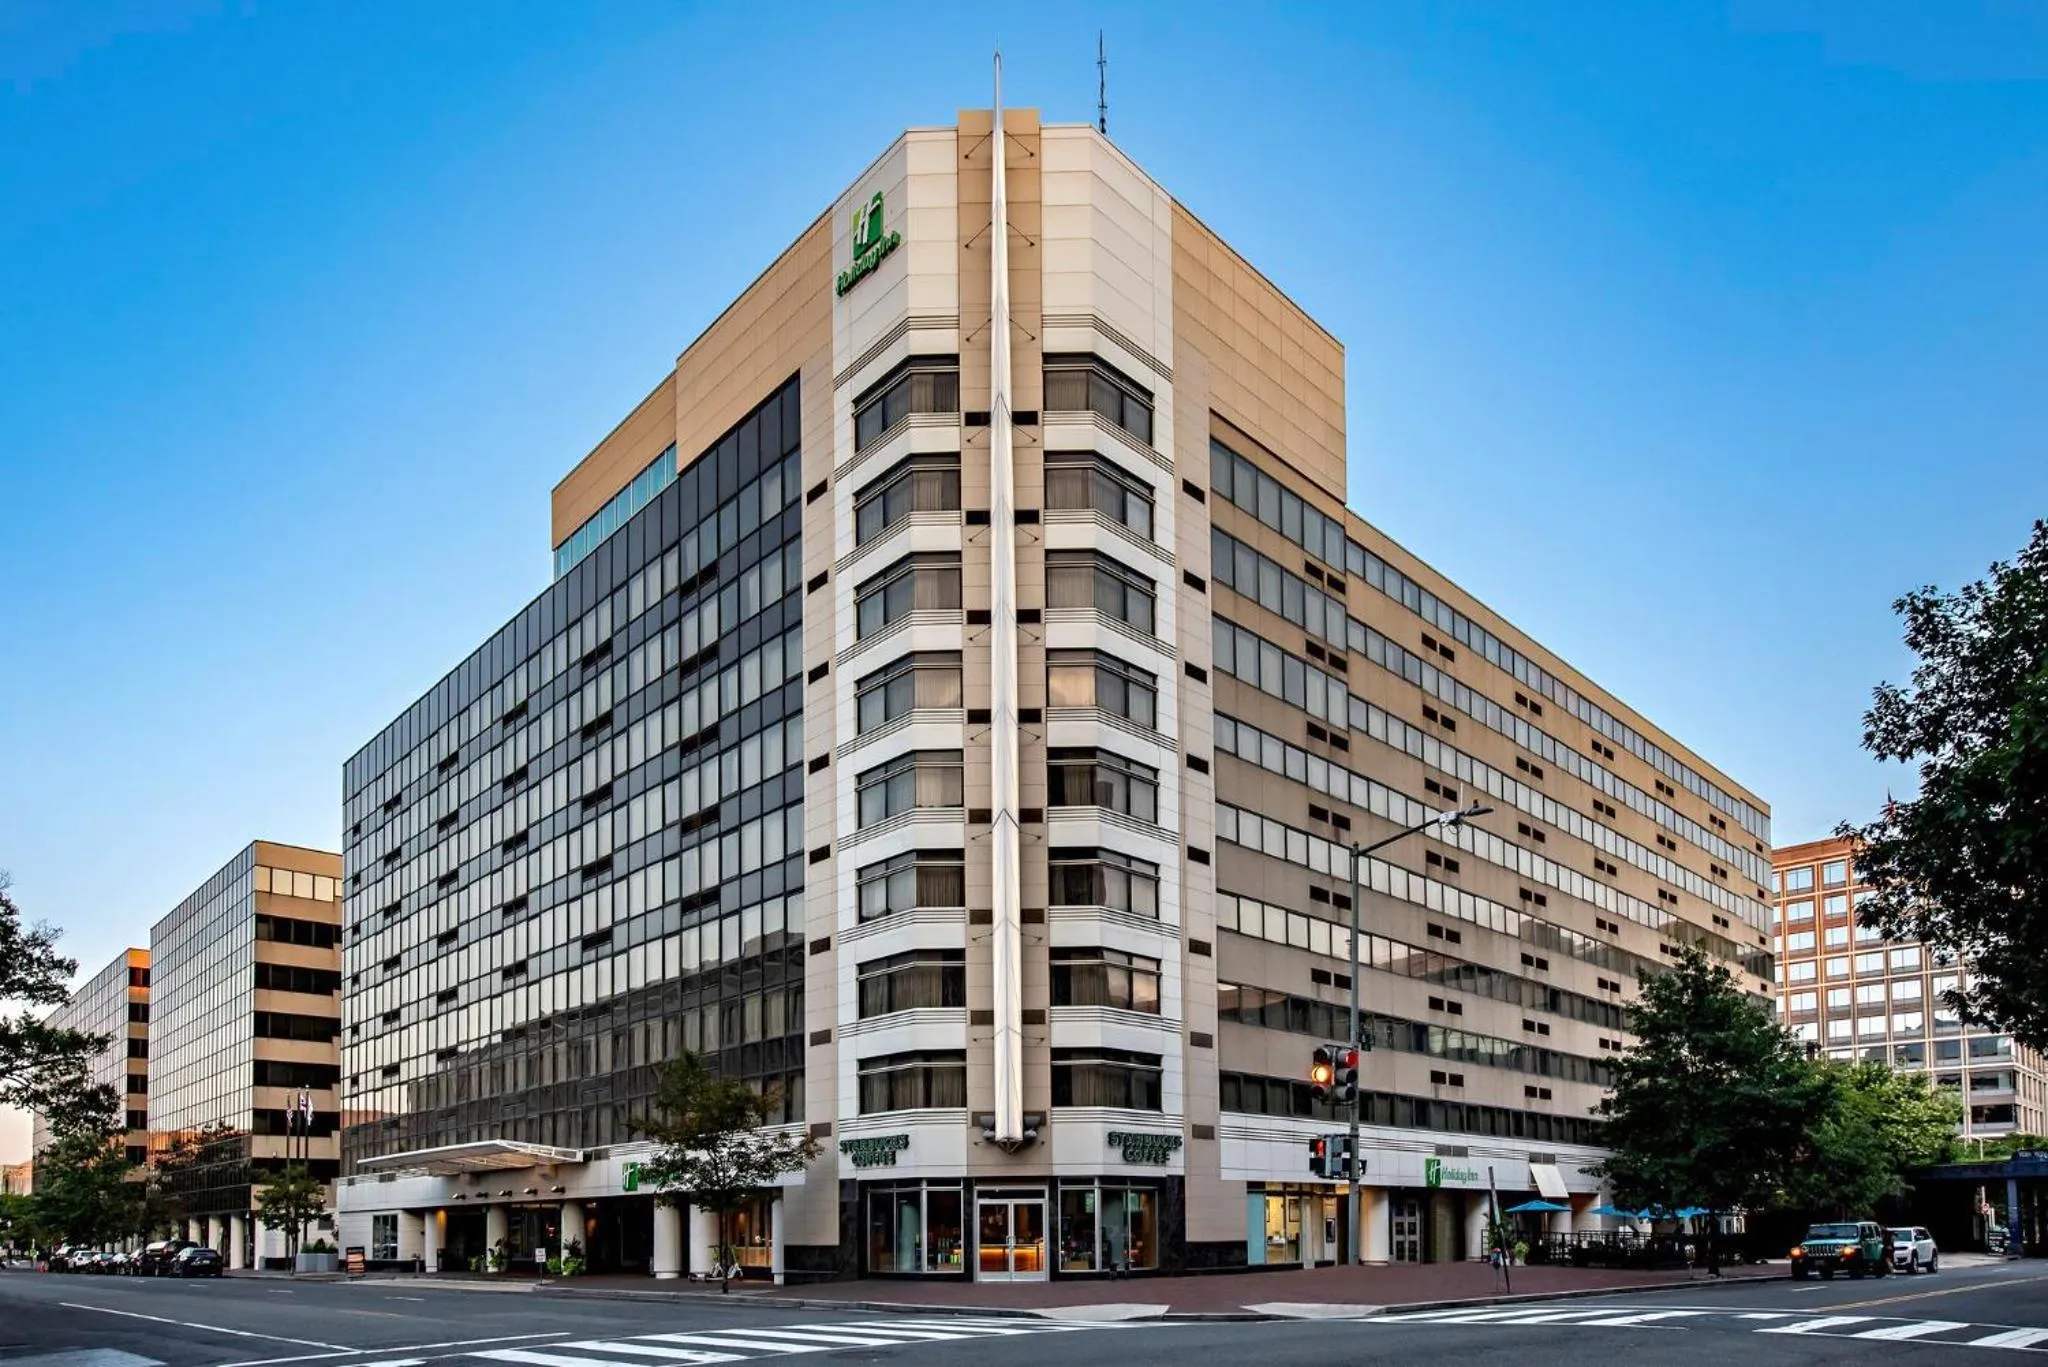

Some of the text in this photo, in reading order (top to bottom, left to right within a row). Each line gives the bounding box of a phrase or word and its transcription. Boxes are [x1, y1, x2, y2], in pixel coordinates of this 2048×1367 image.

[839, 1134, 910, 1154] STARBUCKS
[1108, 1132, 1182, 1150] STARBUCKS
[851, 1150, 896, 1167] COFFEE
[1123, 1146, 1170, 1163] COFFEE
[1441, 1166, 1479, 1184] Holiday Inn
